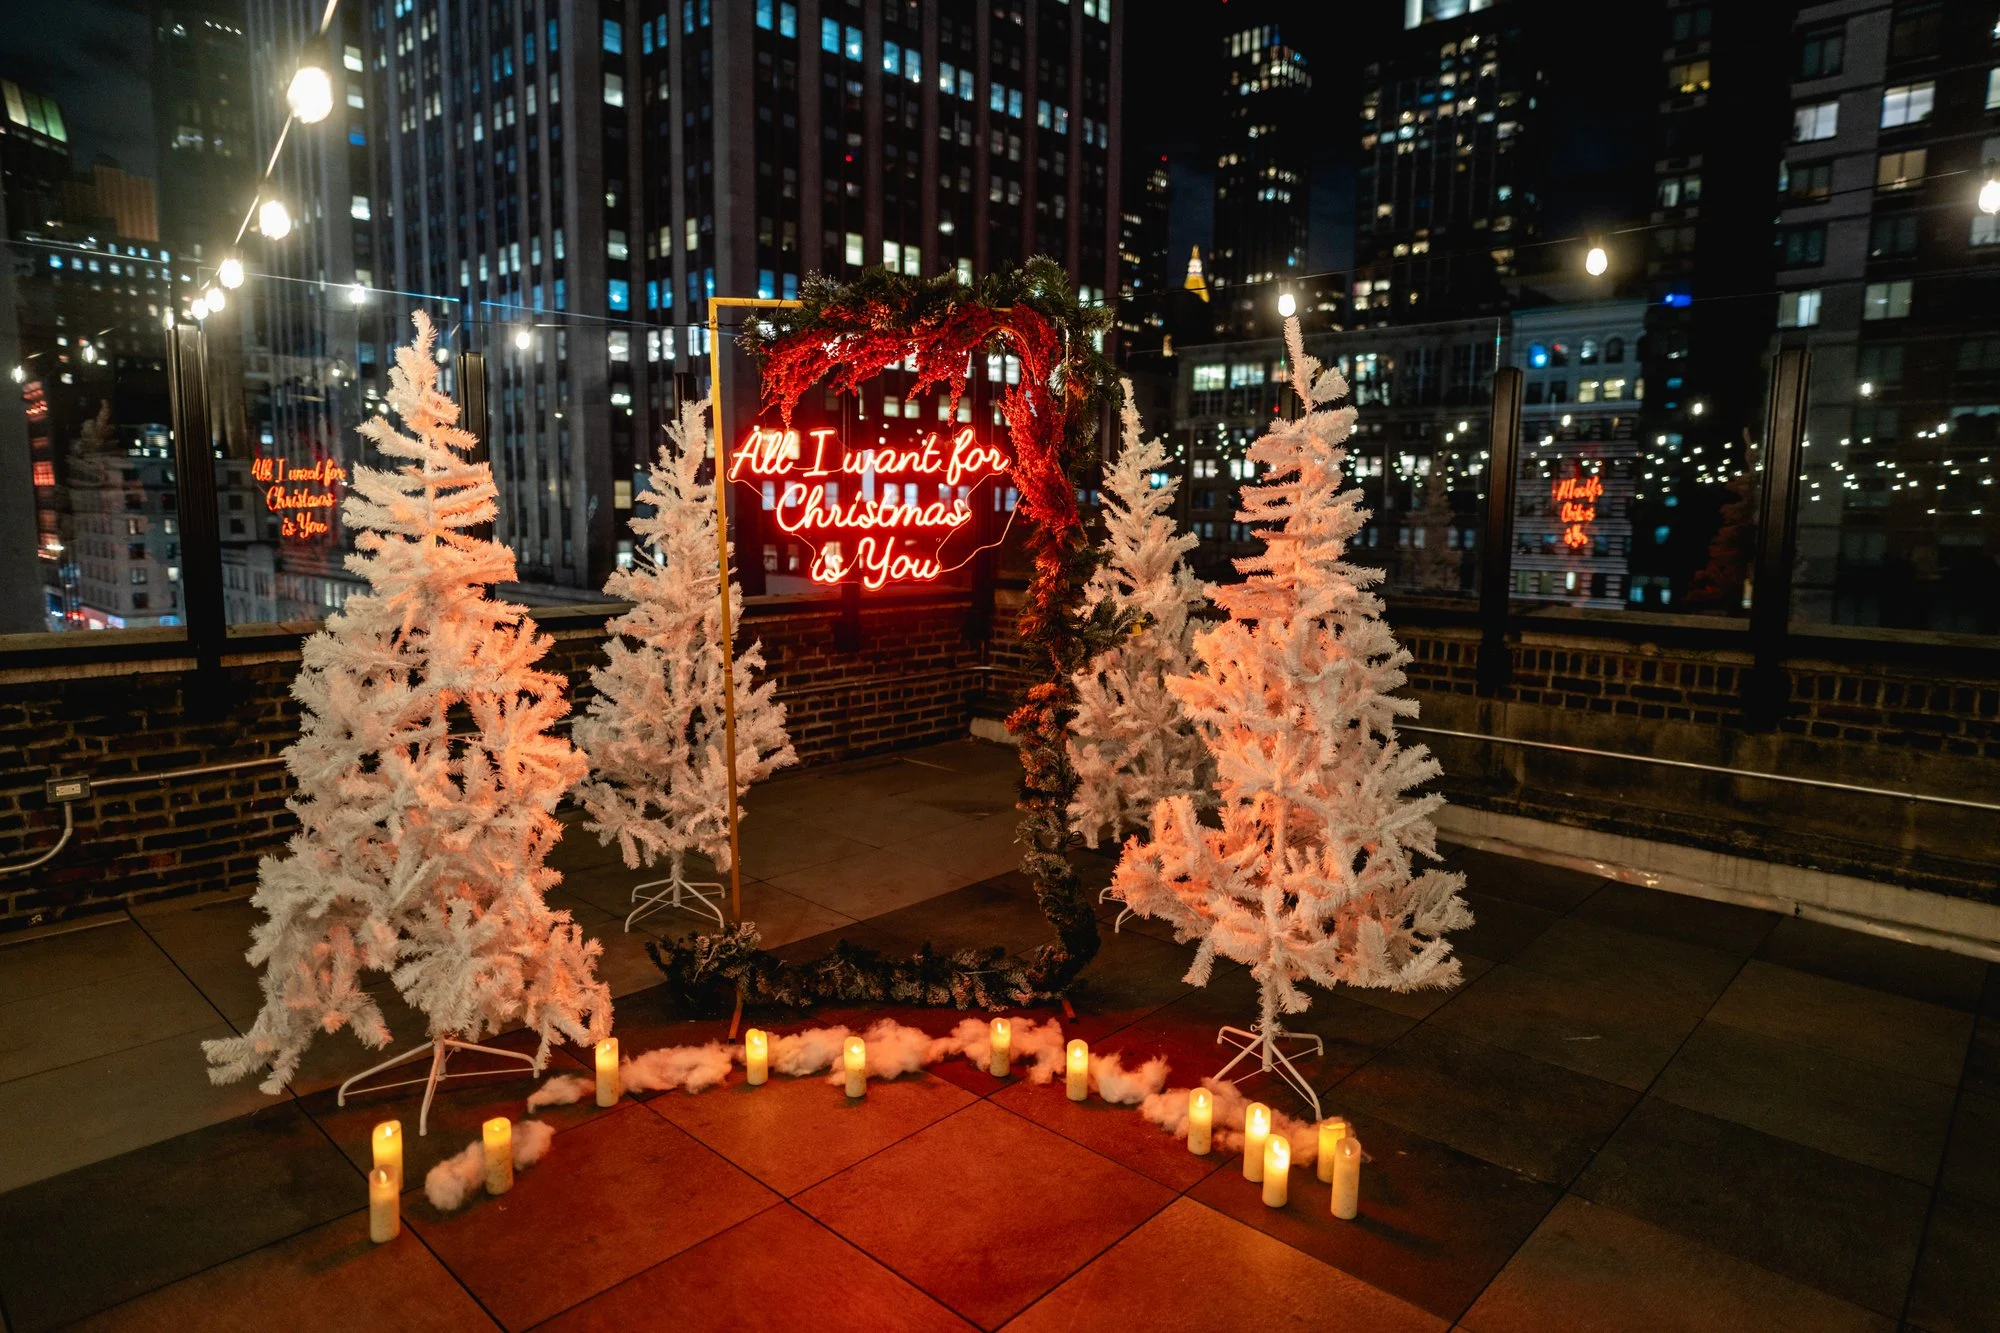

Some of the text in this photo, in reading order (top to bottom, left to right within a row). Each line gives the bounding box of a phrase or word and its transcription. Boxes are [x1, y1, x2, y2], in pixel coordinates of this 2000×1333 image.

[324, 458, 346, 487] for
[730, 428, 1010, 486] All I want for
[282, 511, 328, 538] is You
[775, 482, 971, 532] Christmas
[812, 536, 941, 589] is You
